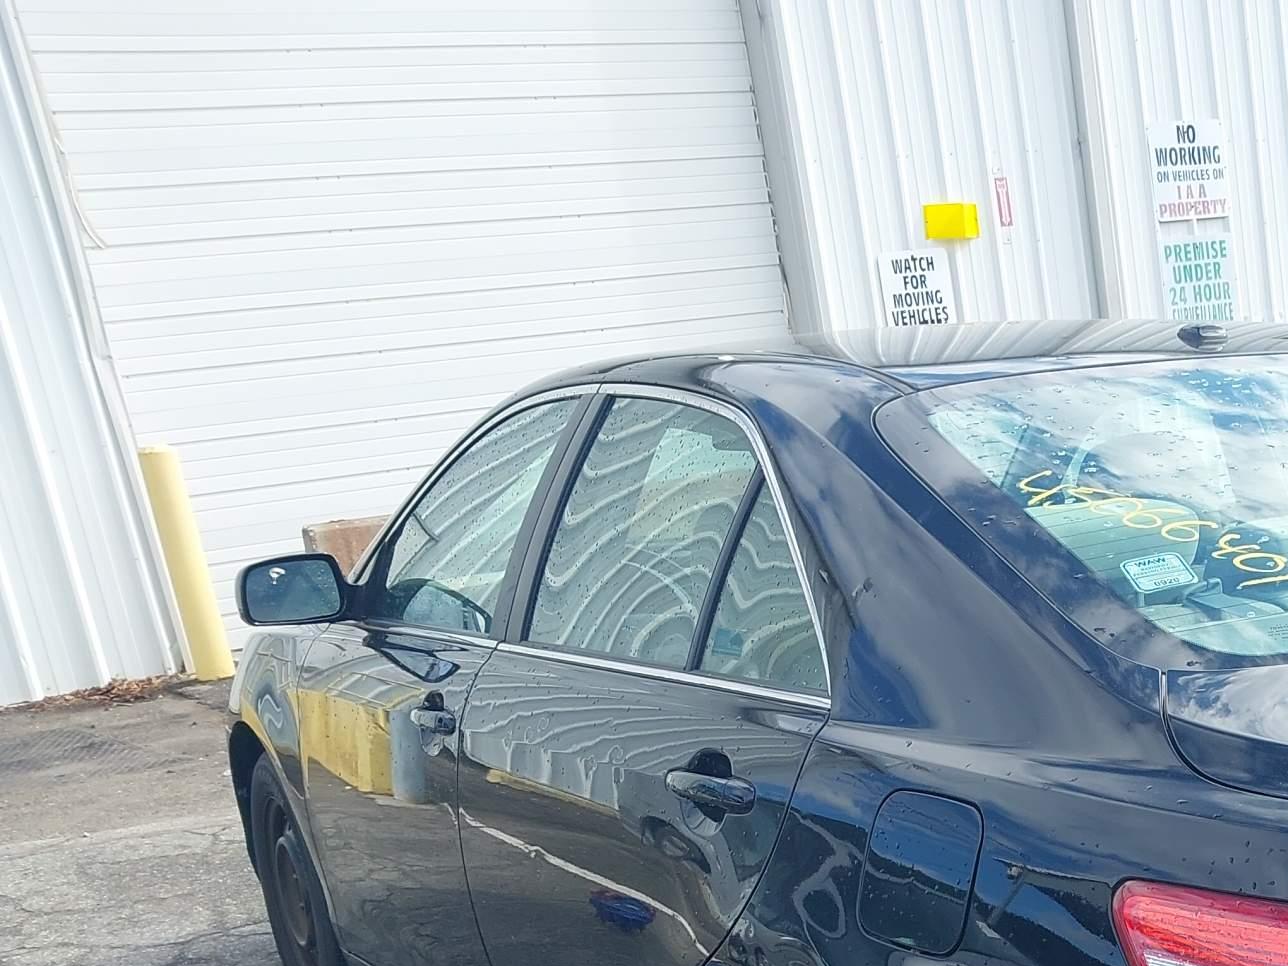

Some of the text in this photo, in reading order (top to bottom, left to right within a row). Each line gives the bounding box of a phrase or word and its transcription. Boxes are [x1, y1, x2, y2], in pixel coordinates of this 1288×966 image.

[1176, 124, 1196, 144] NO
[1155, 145, 1221, 167] WORKING
[1156, 167, 1225, 183] ON VEHICLES ON
[1159, 198, 1226, 218] PROPERTY
[1164, 239, 1227, 263] PREMISE
[891, 255, 935, 274] WATCH
[1172, 261, 1222, 284] UNDER
[903, 274, 927, 291] FOR
[893, 289, 943, 309] MOVING
[1169, 281, 1231, 306] 24 HOUR
[892, 306, 949, 327] VEHICLES
